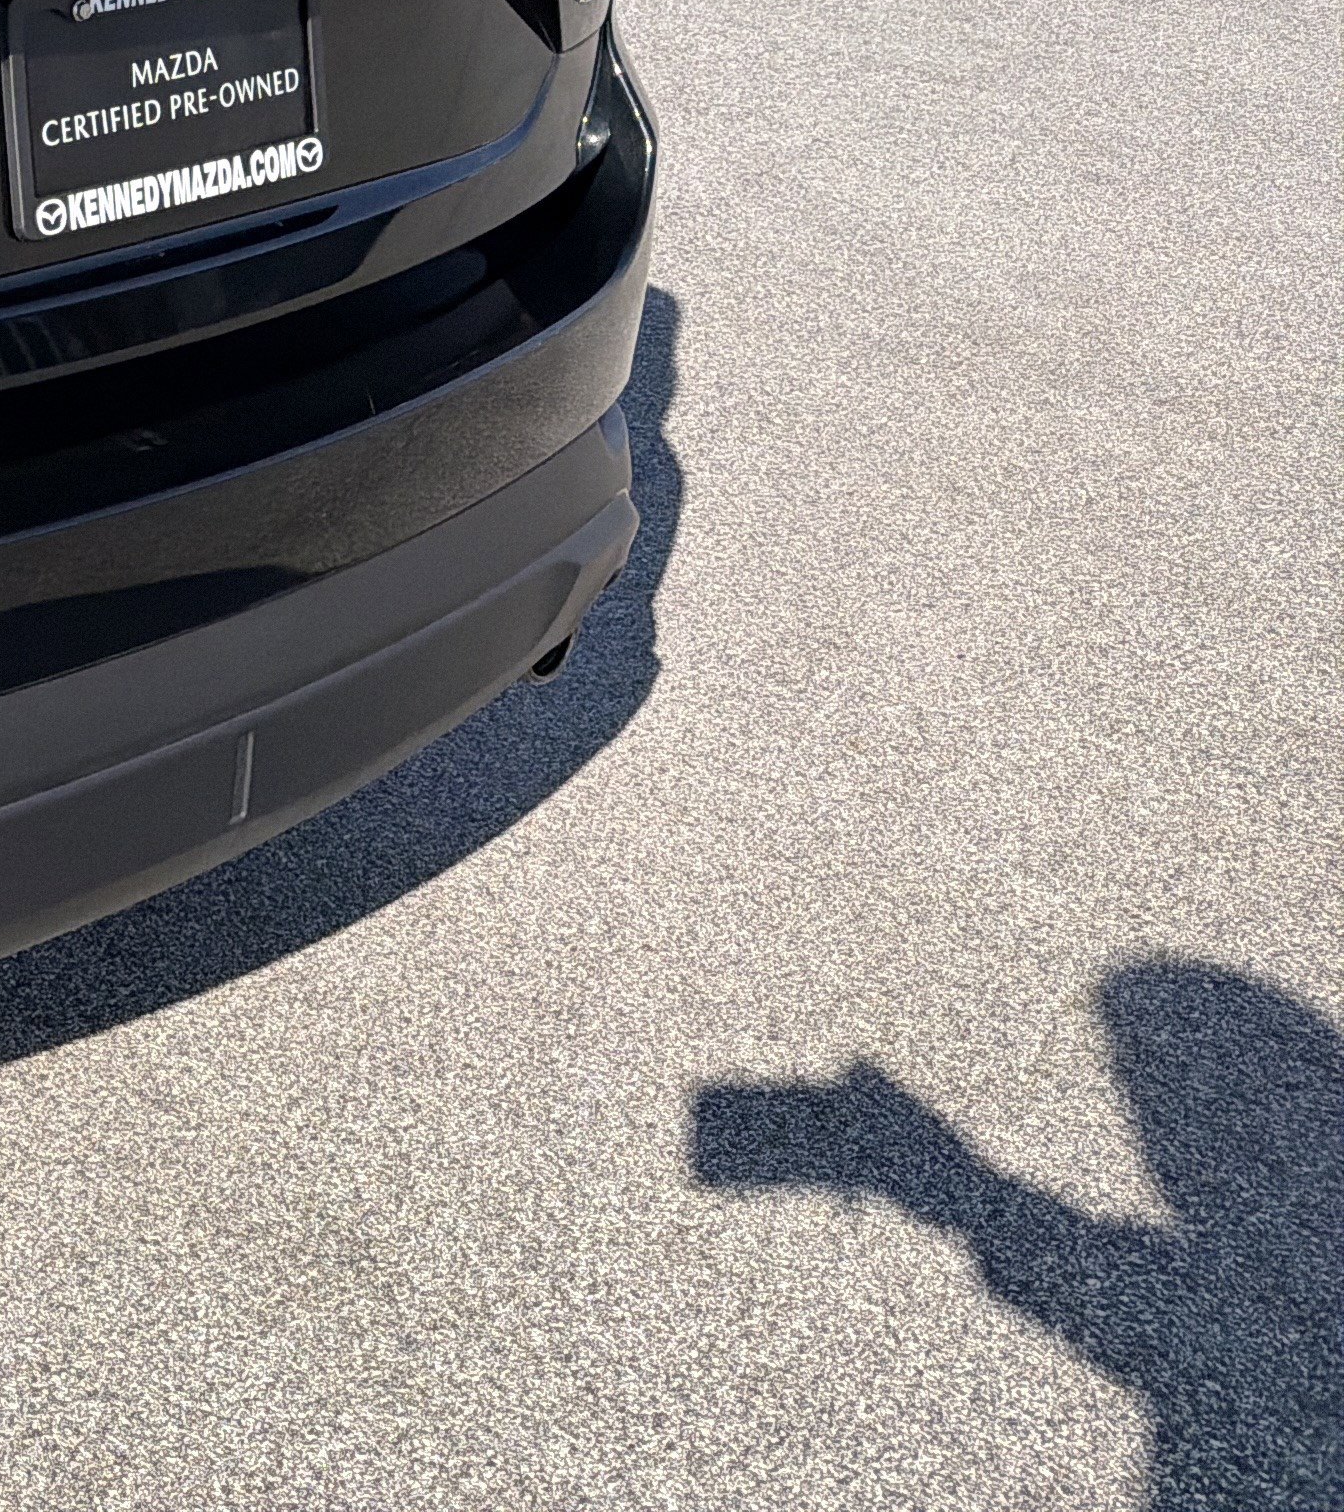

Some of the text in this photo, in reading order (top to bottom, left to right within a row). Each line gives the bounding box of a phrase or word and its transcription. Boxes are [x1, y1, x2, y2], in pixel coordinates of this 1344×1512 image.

[41, 67, 300, 147] CERTIFIED PRE-OWNED
[131, 46, 219, 88] MAZDA
[68, 141, 298, 231] KENNEDYMAZDA.COM
